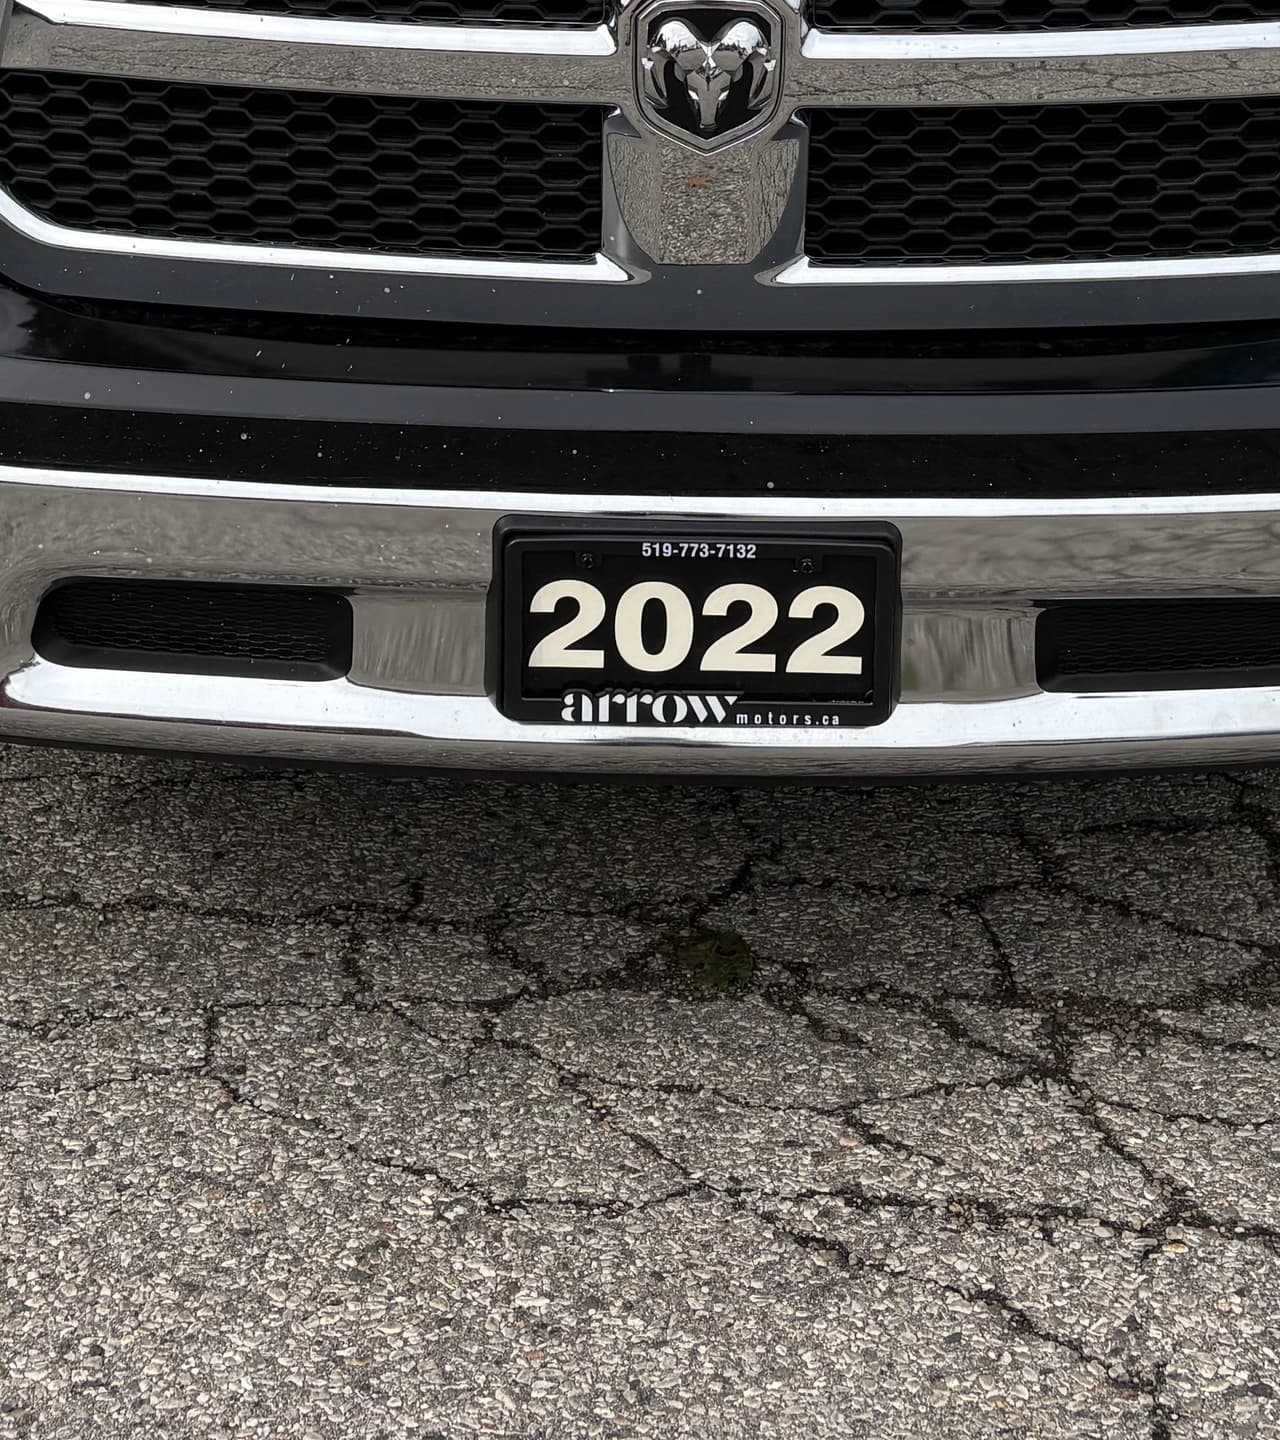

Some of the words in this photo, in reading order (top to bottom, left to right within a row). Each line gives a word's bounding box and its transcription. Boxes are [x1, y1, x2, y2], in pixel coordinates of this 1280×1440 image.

[641, 542, 757, 559] 519-773-7132
[528, 579, 865, 675] 2022
[561, 692, 738, 723] arrow
[736, 712, 840, 726] motors.ca
